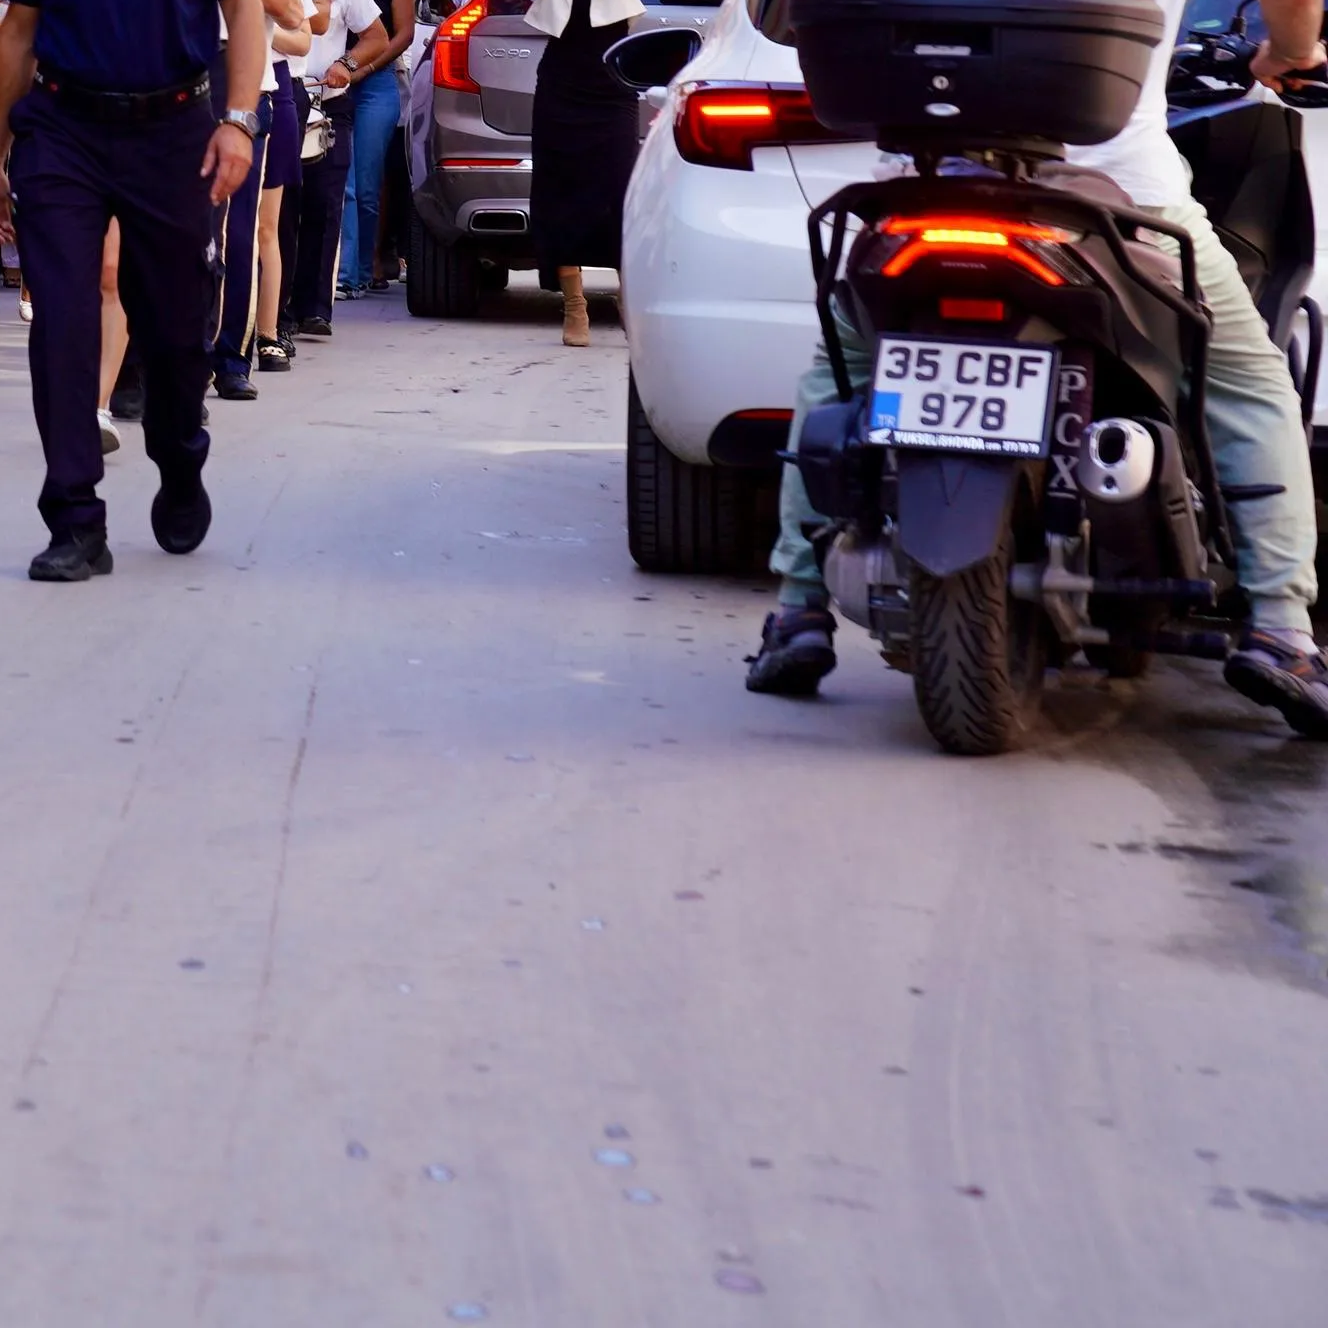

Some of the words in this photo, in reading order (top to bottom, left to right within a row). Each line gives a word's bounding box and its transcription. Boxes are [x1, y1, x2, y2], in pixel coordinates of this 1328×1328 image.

[885, 346, 941, 381] 35
[956, 351, 1044, 389] CBF
[920, 392, 1006, 431] 978
